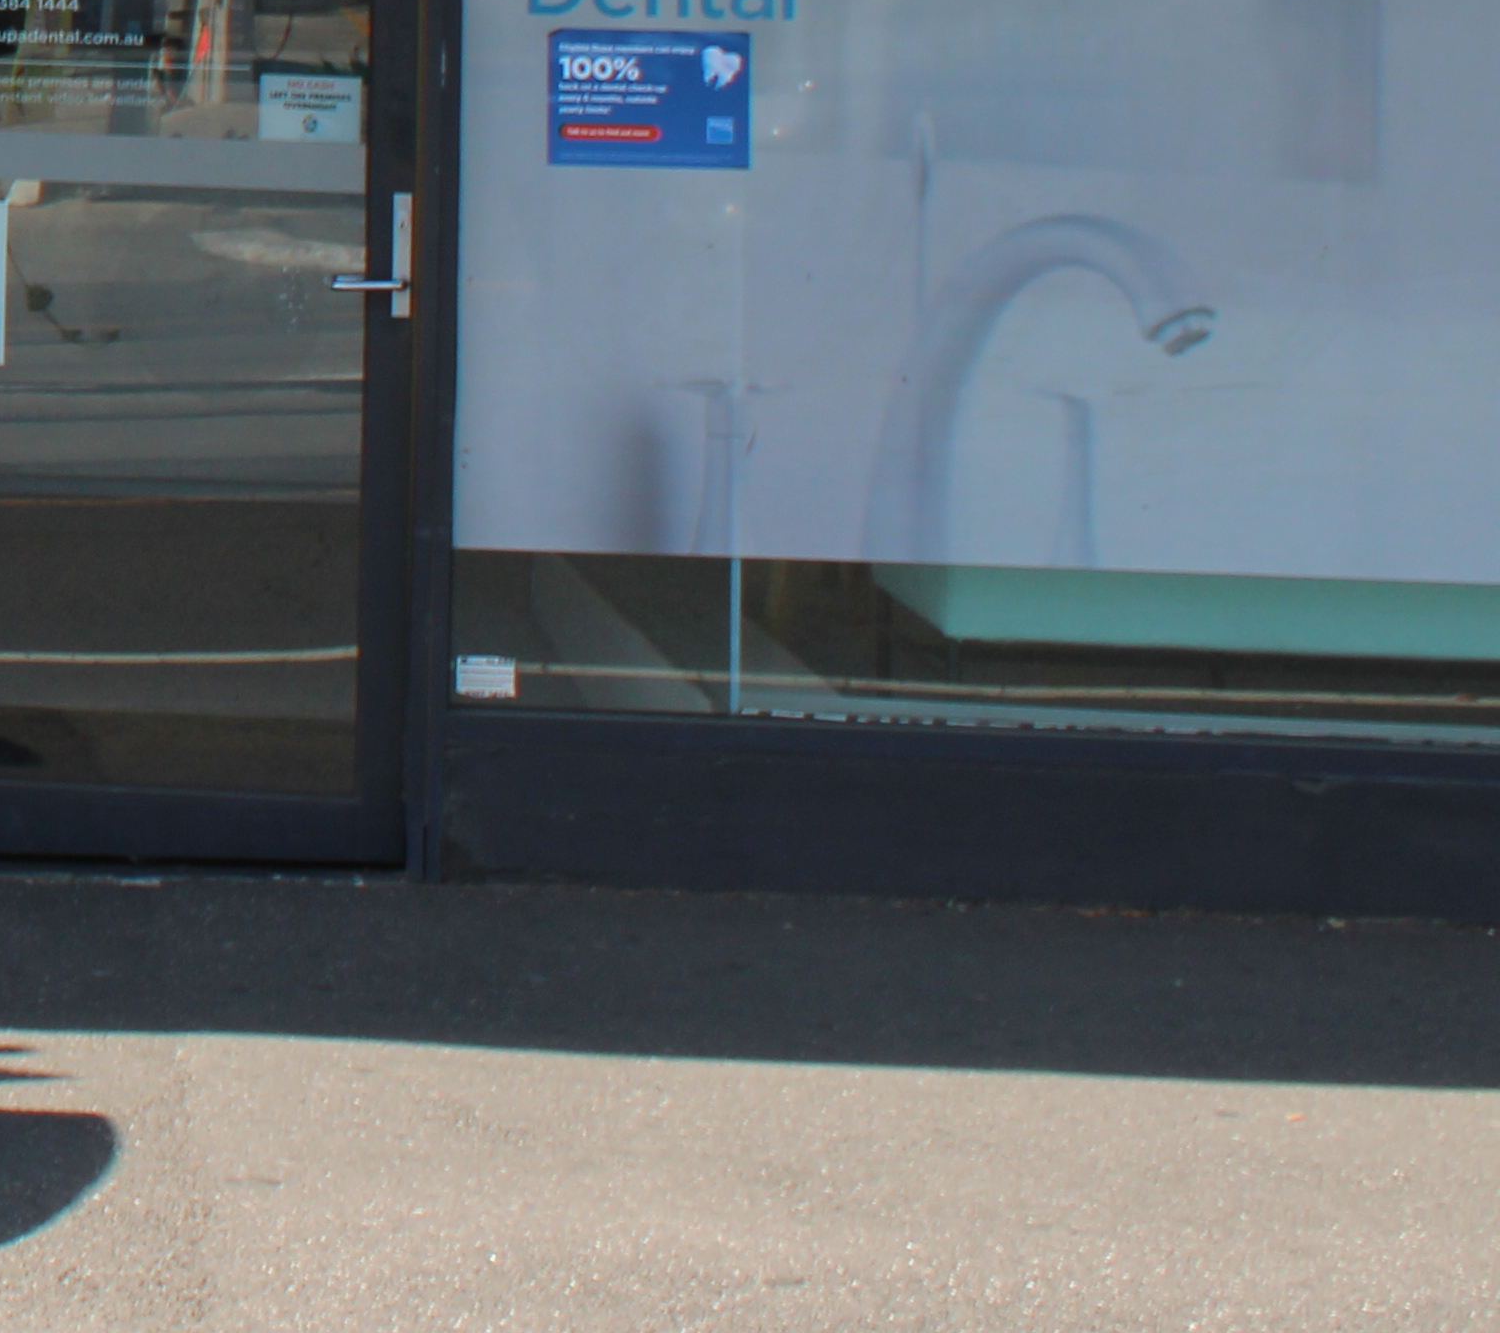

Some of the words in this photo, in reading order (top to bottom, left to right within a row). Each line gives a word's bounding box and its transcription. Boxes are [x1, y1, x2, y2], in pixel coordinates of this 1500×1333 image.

[558, 54, 642, 82] 100%
[28, 76, 96, 91] premises
[100, 79, 115, 89] are
[117, 77, 157, 90] under
[47, 92, 85, 105] video
